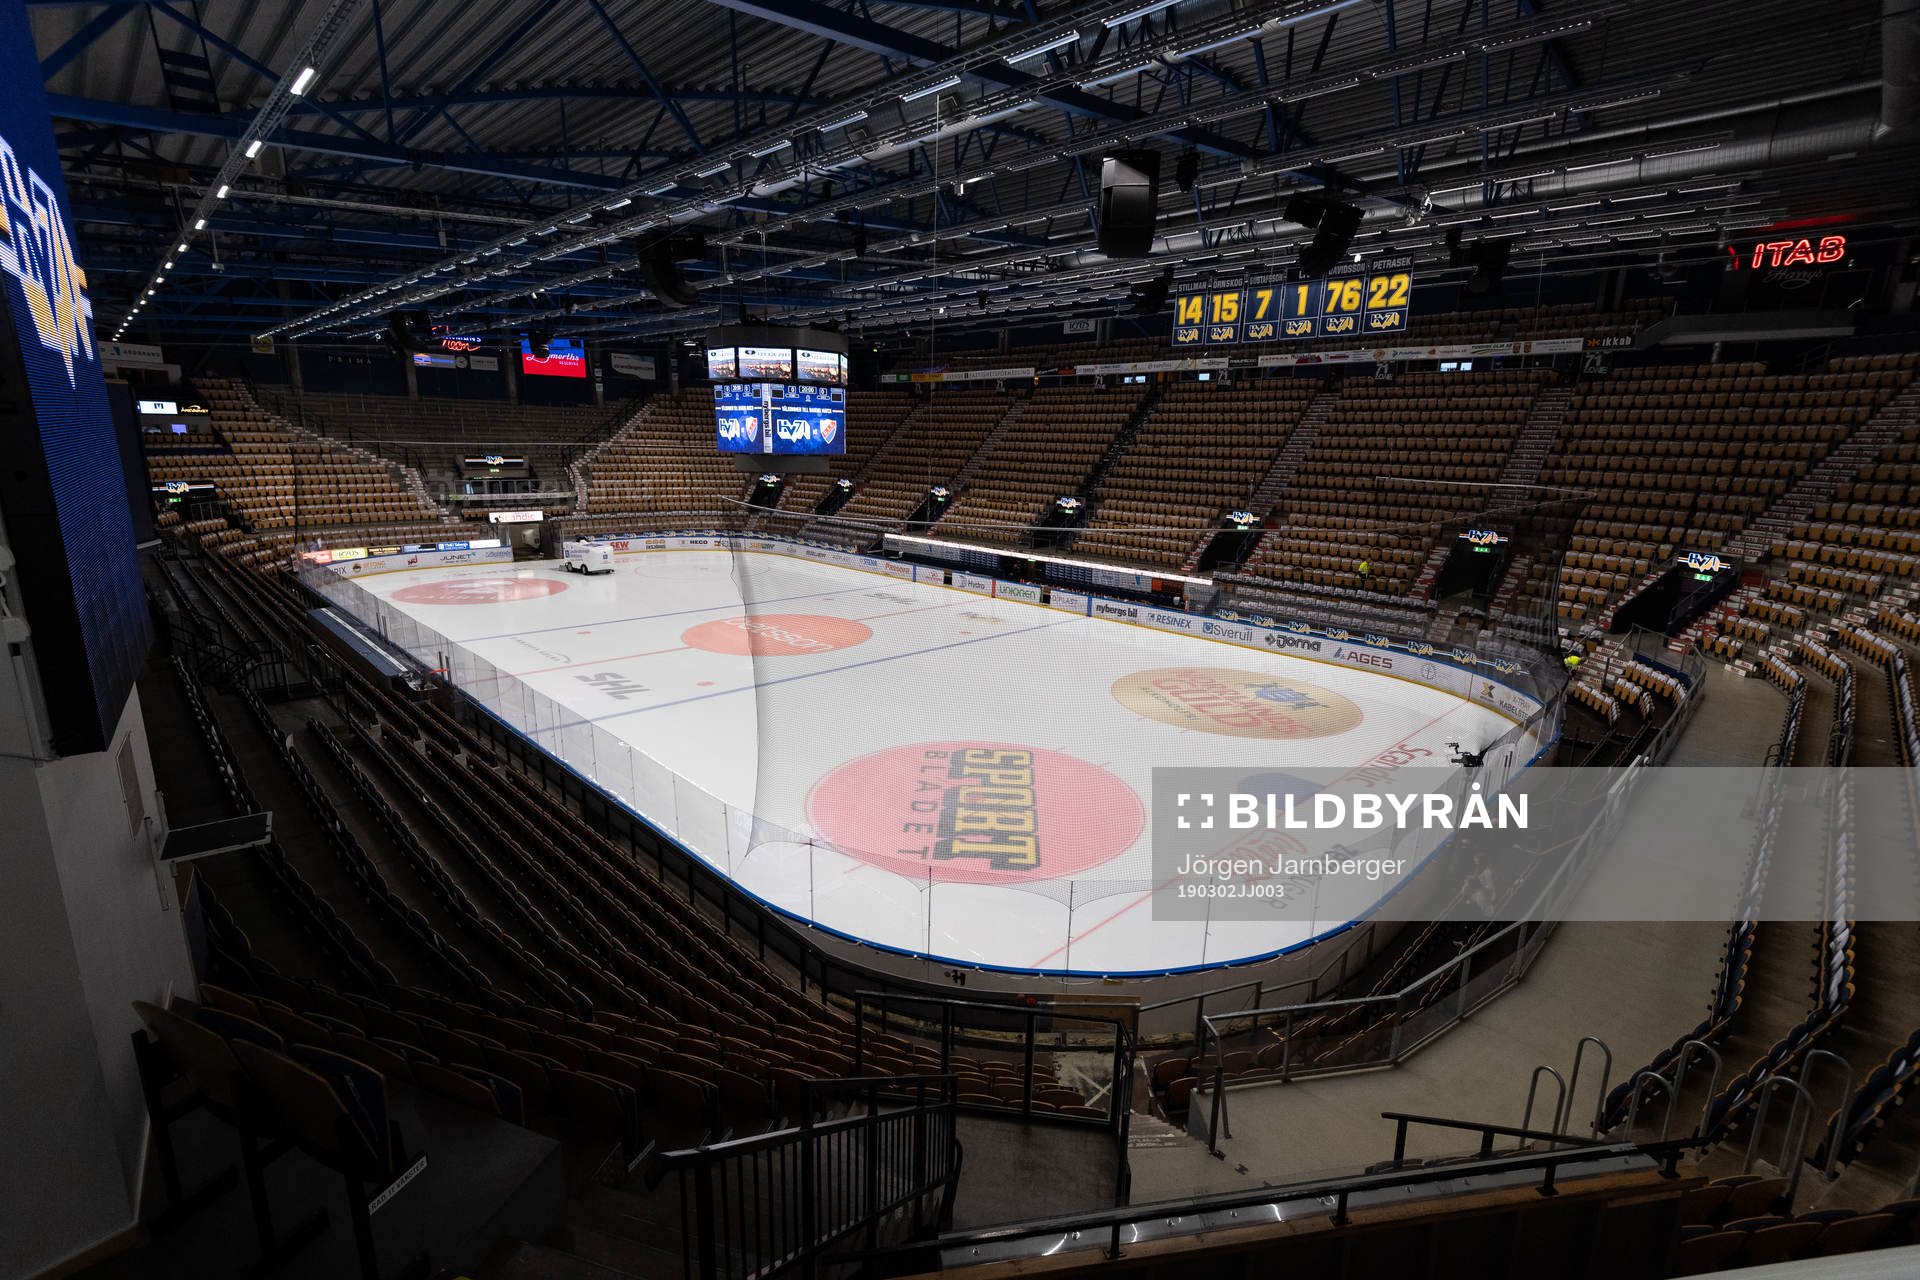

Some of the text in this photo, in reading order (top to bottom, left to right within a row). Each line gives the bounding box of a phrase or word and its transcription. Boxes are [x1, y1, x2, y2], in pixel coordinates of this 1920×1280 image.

[1752, 235, 1846, 268] ITAB
[1373, 256, 1411, 270] PETRASEK
[1178, 281, 1207, 291] STILLMAN
[1212, 277, 1243, 289] ÖRNSKOG
[1249, 274, 1283, 285] GUSTAFSSON
[1297, 284, 1309, 316] 1
[1325, 279, 1363, 313] 76
[1367, 273, 1411, 310] 22
[1178, 296, 1203, 326] 14
[1212, 292, 1240, 324] 15
[1255, 289, 1273, 319] 7
[1286, 319, 1312, 336] HV71
[1326, 315, 1354, 333] HV71
[1370, 311, 1401, 330] HV71
[1177, 329, 1199, 343] HV71
[1210, 326, 1234, 342] HV71
[1249, 323, 1273, 339] HV71
[719, 418, 741, 441] HV71
[776, 418, 811, 443] HV71
[499, 512, 535, 522] Scandic
[610, 541, 629, 549] SEW
[1468, 529, 1499, 545] HV71
[440, 553, 471, 561] JUNET
[1687, 552, 1721, 572] HV71
[1095, 603, 1138, 619] nybergs bil
[1155, 614, 1192, 629] RESINEX
[1212, 624, 1254, 642] Sverull
[1346, 650, 1393, 669] AGES
[573, 672, 652, 700] SHL
[897, 750, 949, 861] BLADET
[933, 748, 1041, 872] SPORT
